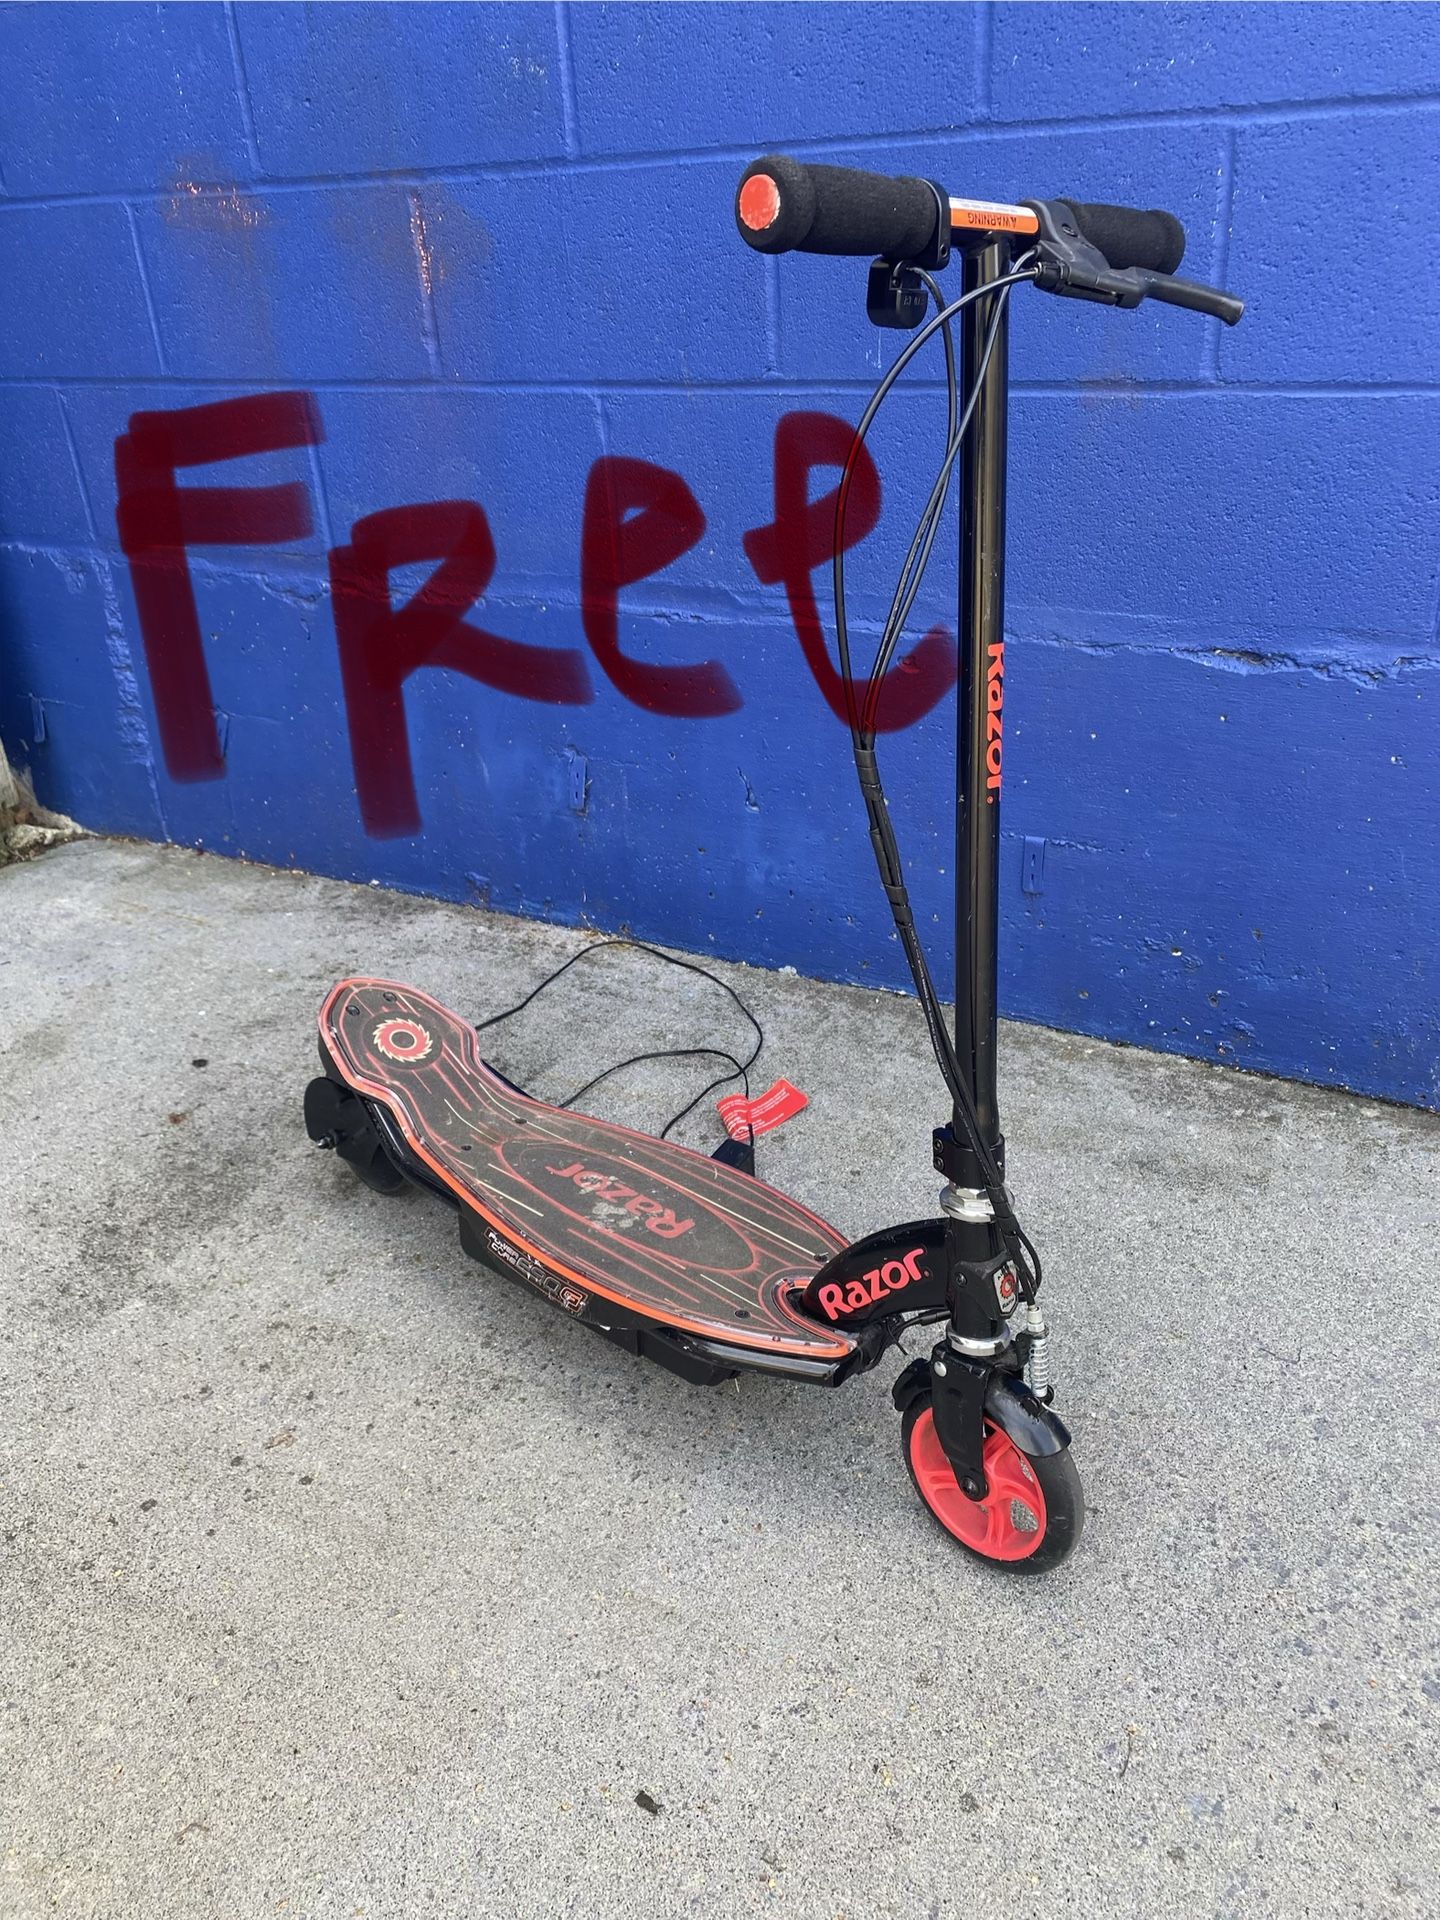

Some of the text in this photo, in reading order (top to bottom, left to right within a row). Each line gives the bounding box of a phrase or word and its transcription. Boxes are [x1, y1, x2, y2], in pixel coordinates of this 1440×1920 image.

[968, 213, 1011, 228] WARNING
[986, 642, 1005, 802] Razor
[545, 1162, 695, 1239] Razor
[818, 1247, 925, 1321] Razor
